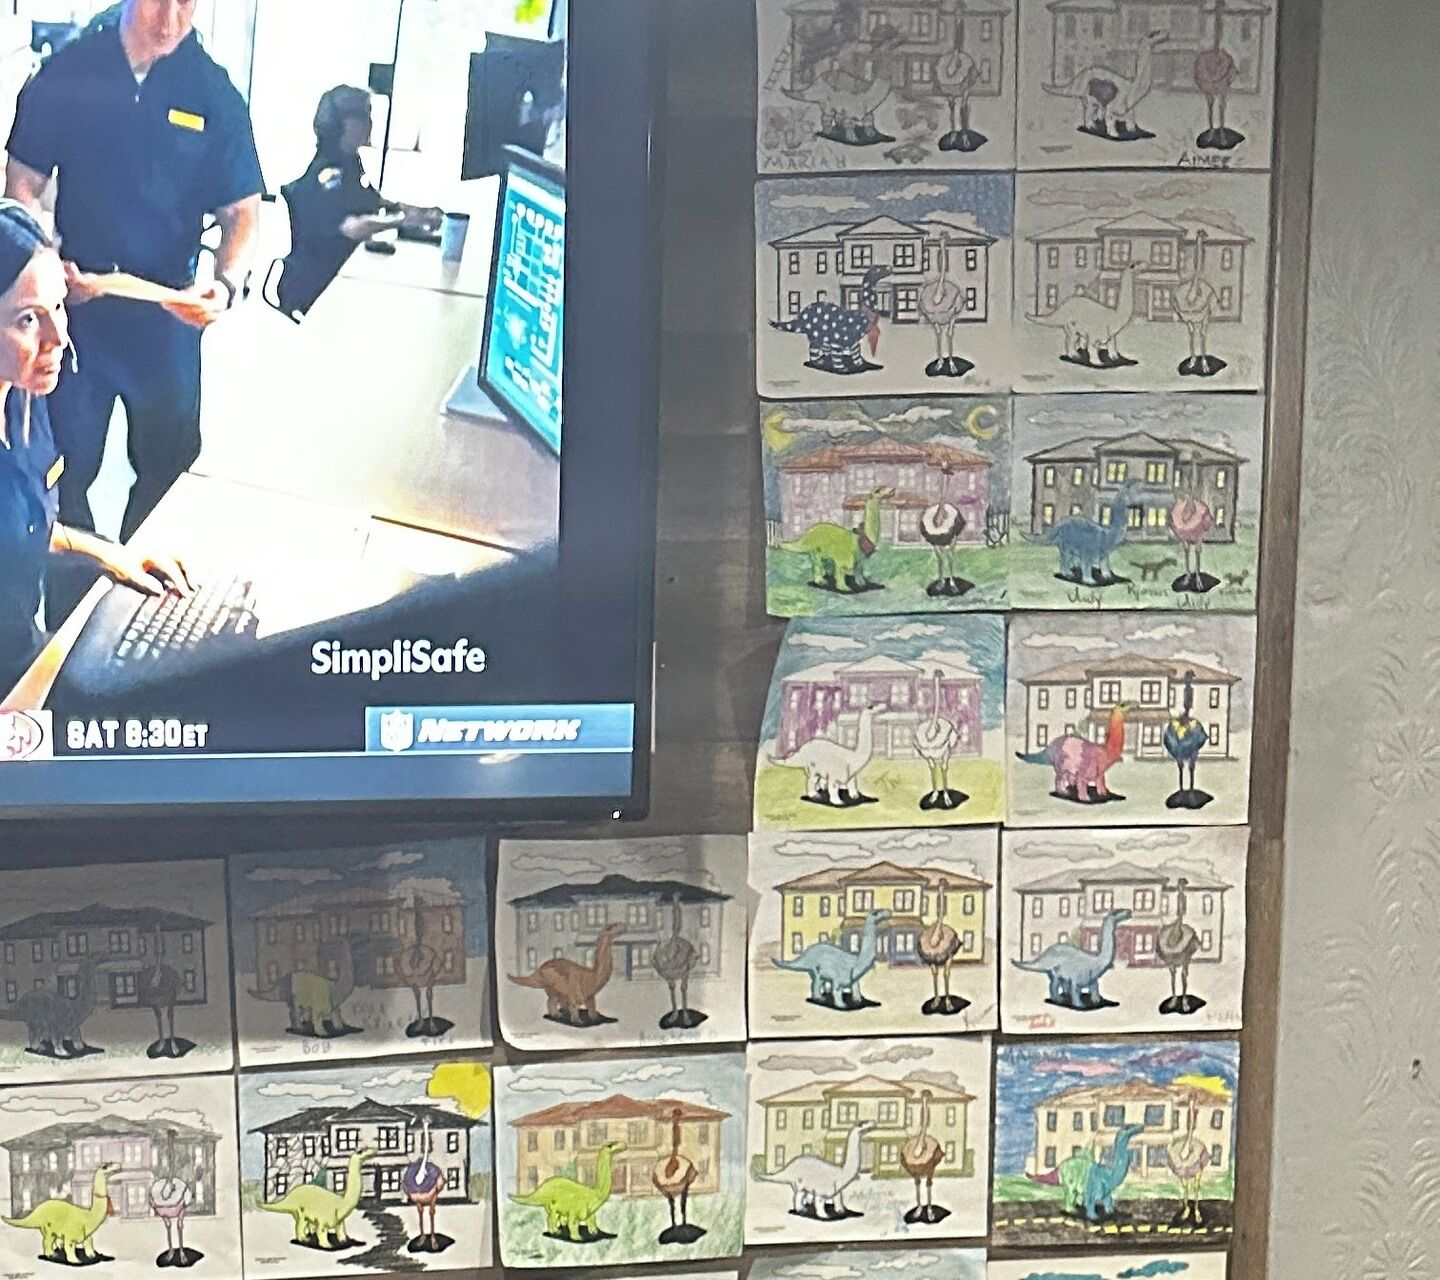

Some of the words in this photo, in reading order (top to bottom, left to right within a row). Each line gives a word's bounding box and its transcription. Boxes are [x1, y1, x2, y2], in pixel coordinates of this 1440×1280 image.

[309, 638, 488, 682] SimpliSafe
[66, 719, 120, 749] SAT
[417, 718, 582, 743] NETWORK
